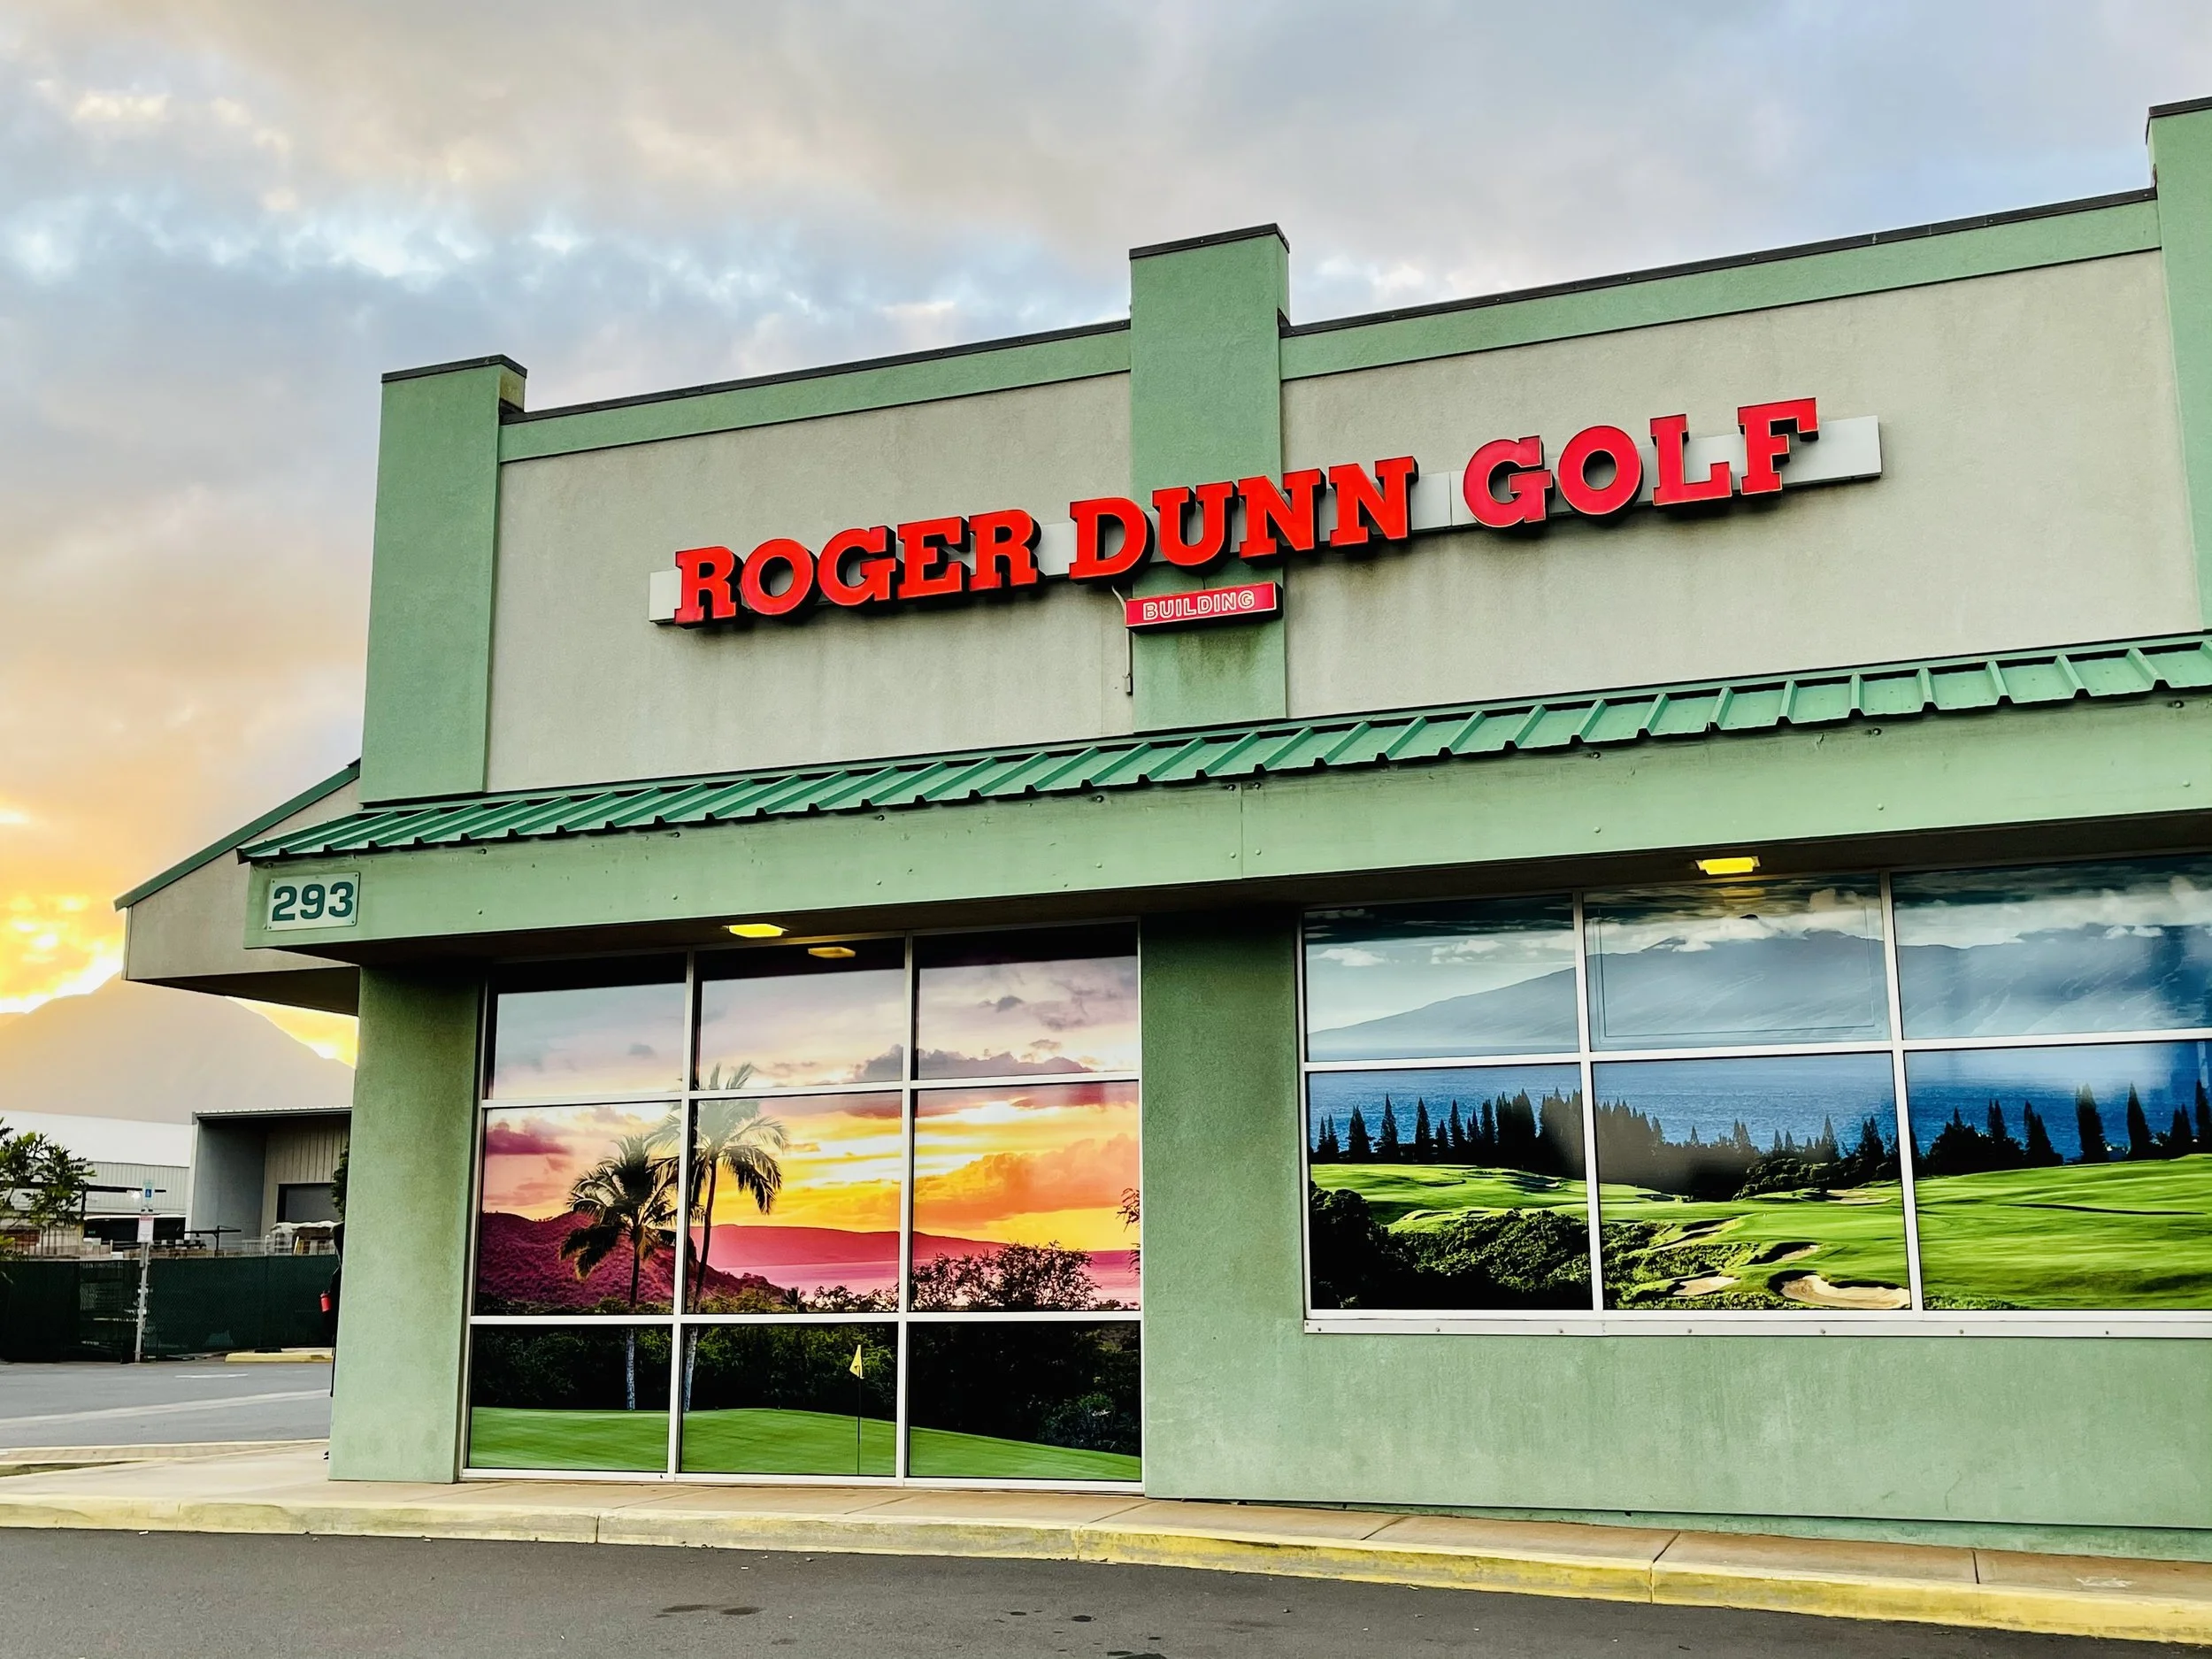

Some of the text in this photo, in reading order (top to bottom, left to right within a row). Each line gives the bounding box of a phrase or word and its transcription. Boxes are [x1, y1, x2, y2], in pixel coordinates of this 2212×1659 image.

[674, 398, 1819, 625] ROGER DUNN GOLF
[1142, 589, 1255, 621] BUILDING
[272, 881, 354, 921] 293
